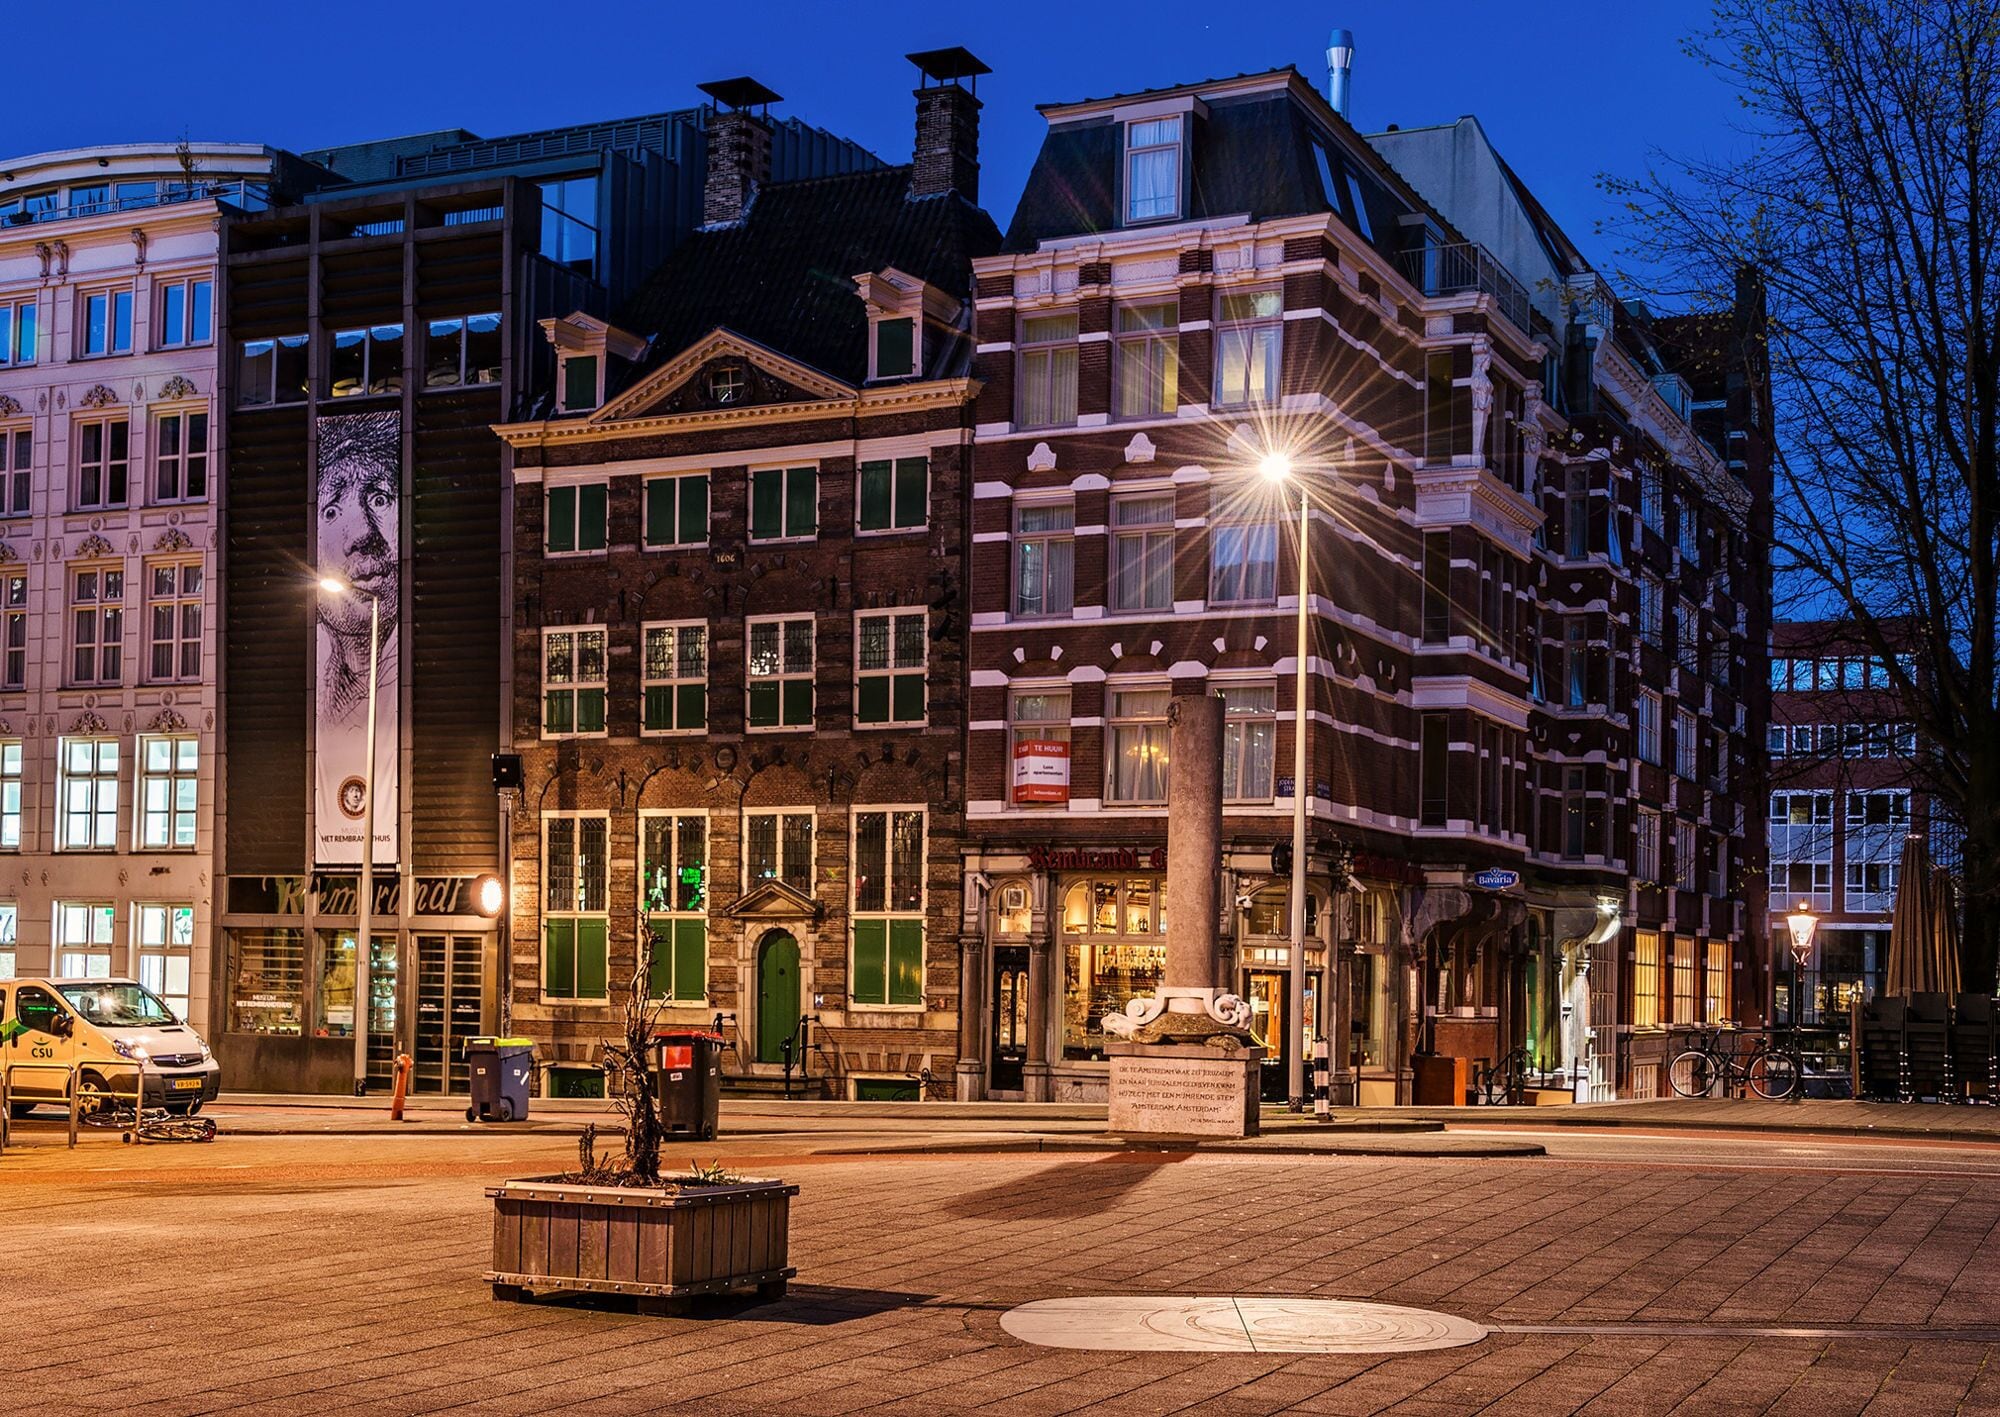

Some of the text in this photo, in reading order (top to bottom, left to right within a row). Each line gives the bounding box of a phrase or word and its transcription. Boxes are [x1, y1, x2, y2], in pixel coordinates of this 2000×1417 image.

[716, 553, 735, 562] 1606
[321, 835, 335, 843] HET
[1479, 874, 1512, 885] Bavaria
[31, 1047, 53, 1058] CSU
[1138, 1066, 1175, 1075] AMSTERDAM
